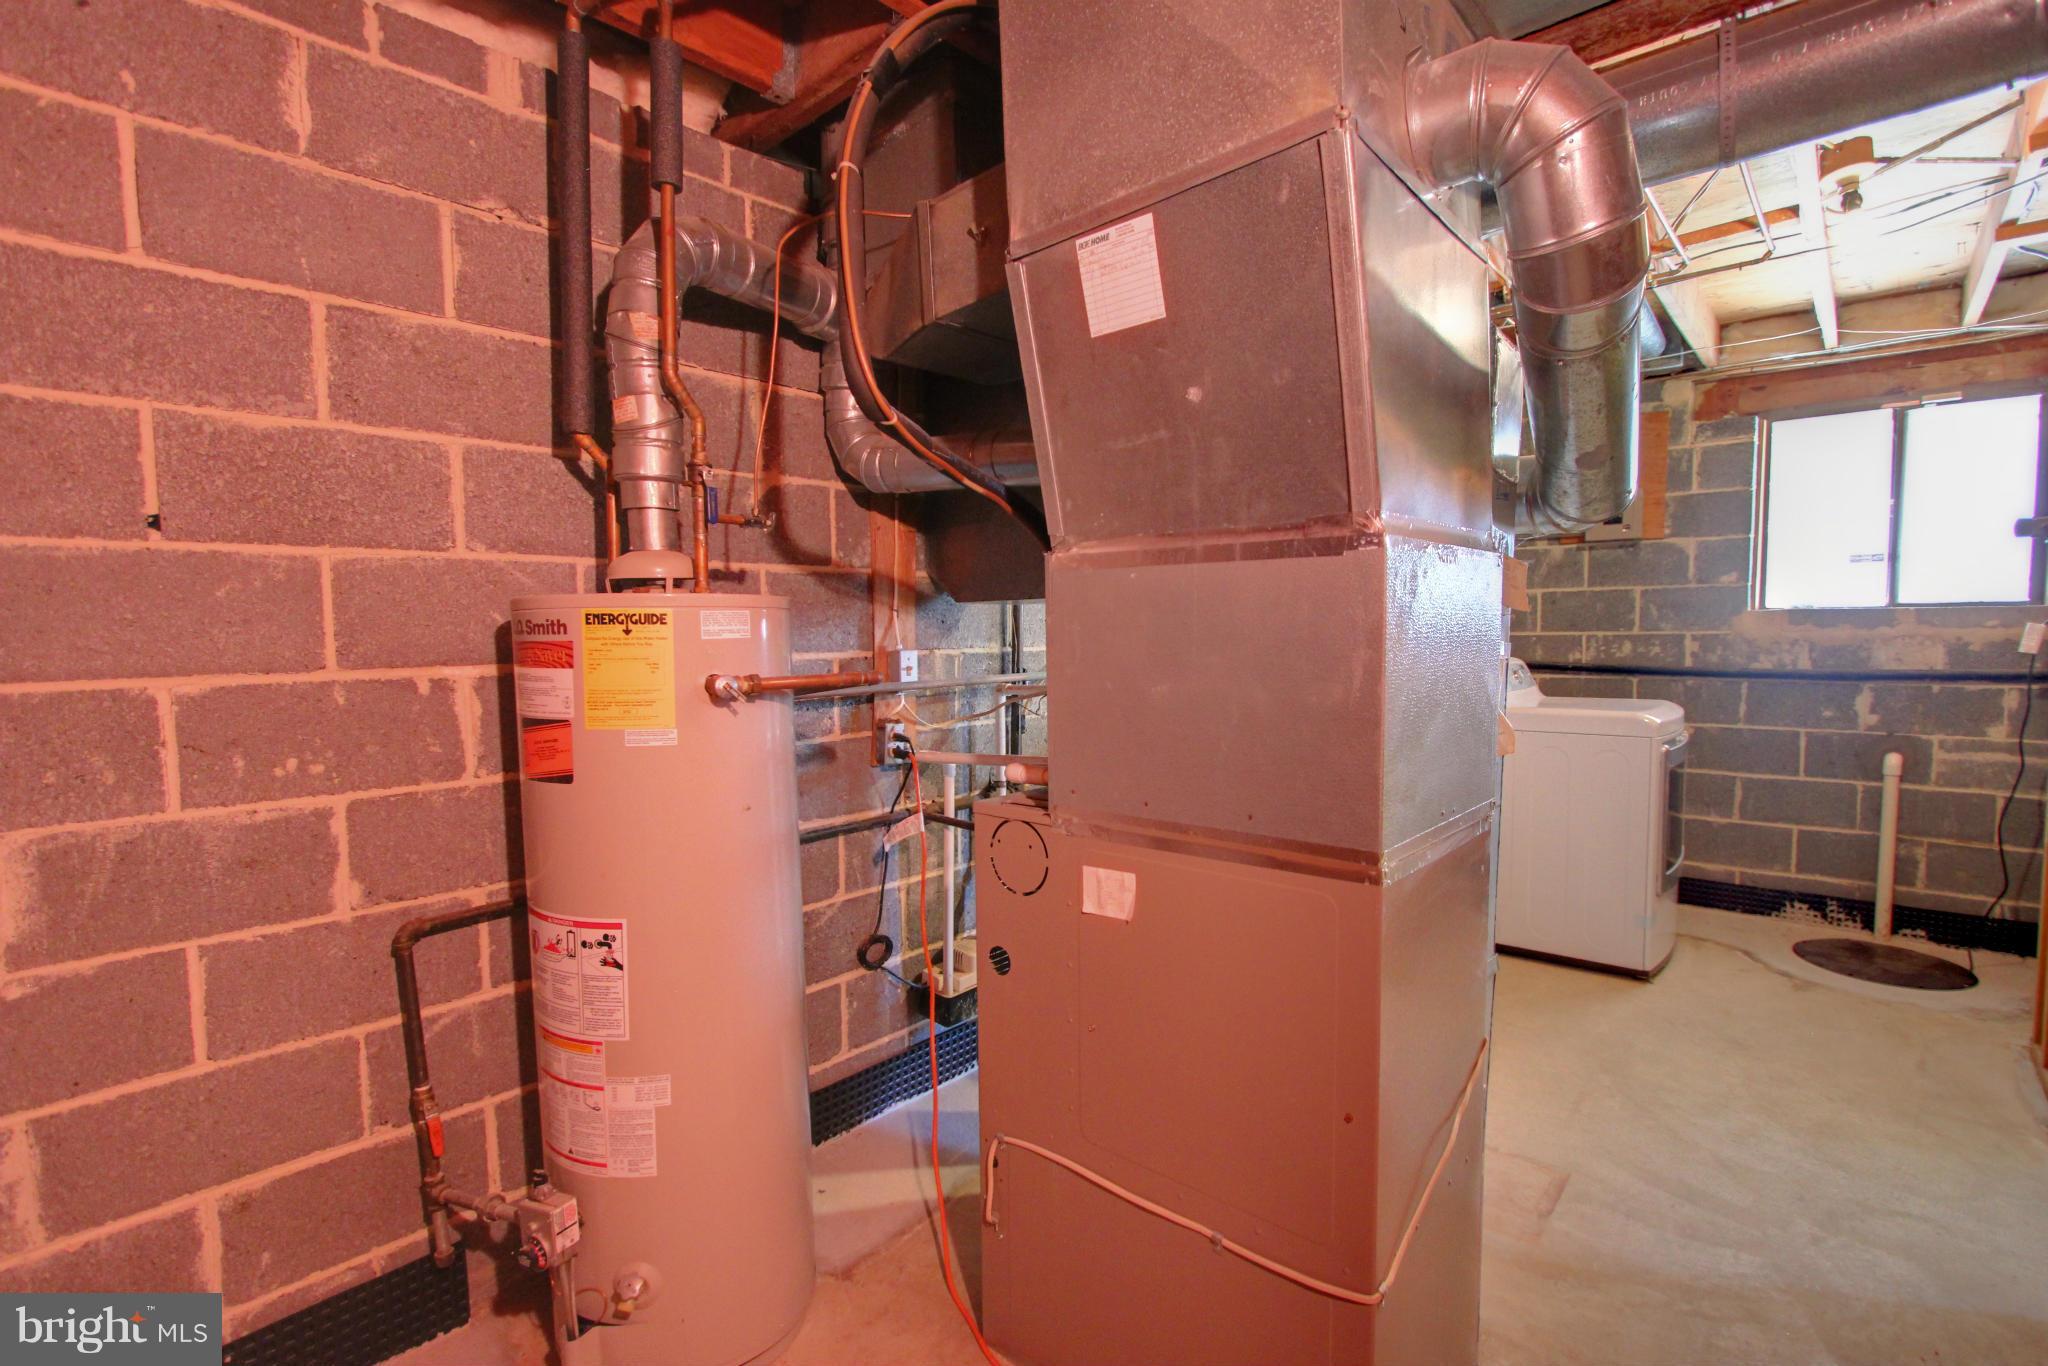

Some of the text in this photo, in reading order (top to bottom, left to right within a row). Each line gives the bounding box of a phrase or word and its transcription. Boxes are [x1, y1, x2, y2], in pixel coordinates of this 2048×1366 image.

[1090, 232, 1111, 247] HOME
[525, 618, 568, 635] Smith
[585, 612, 668, 627] ENERGYGUIDE
